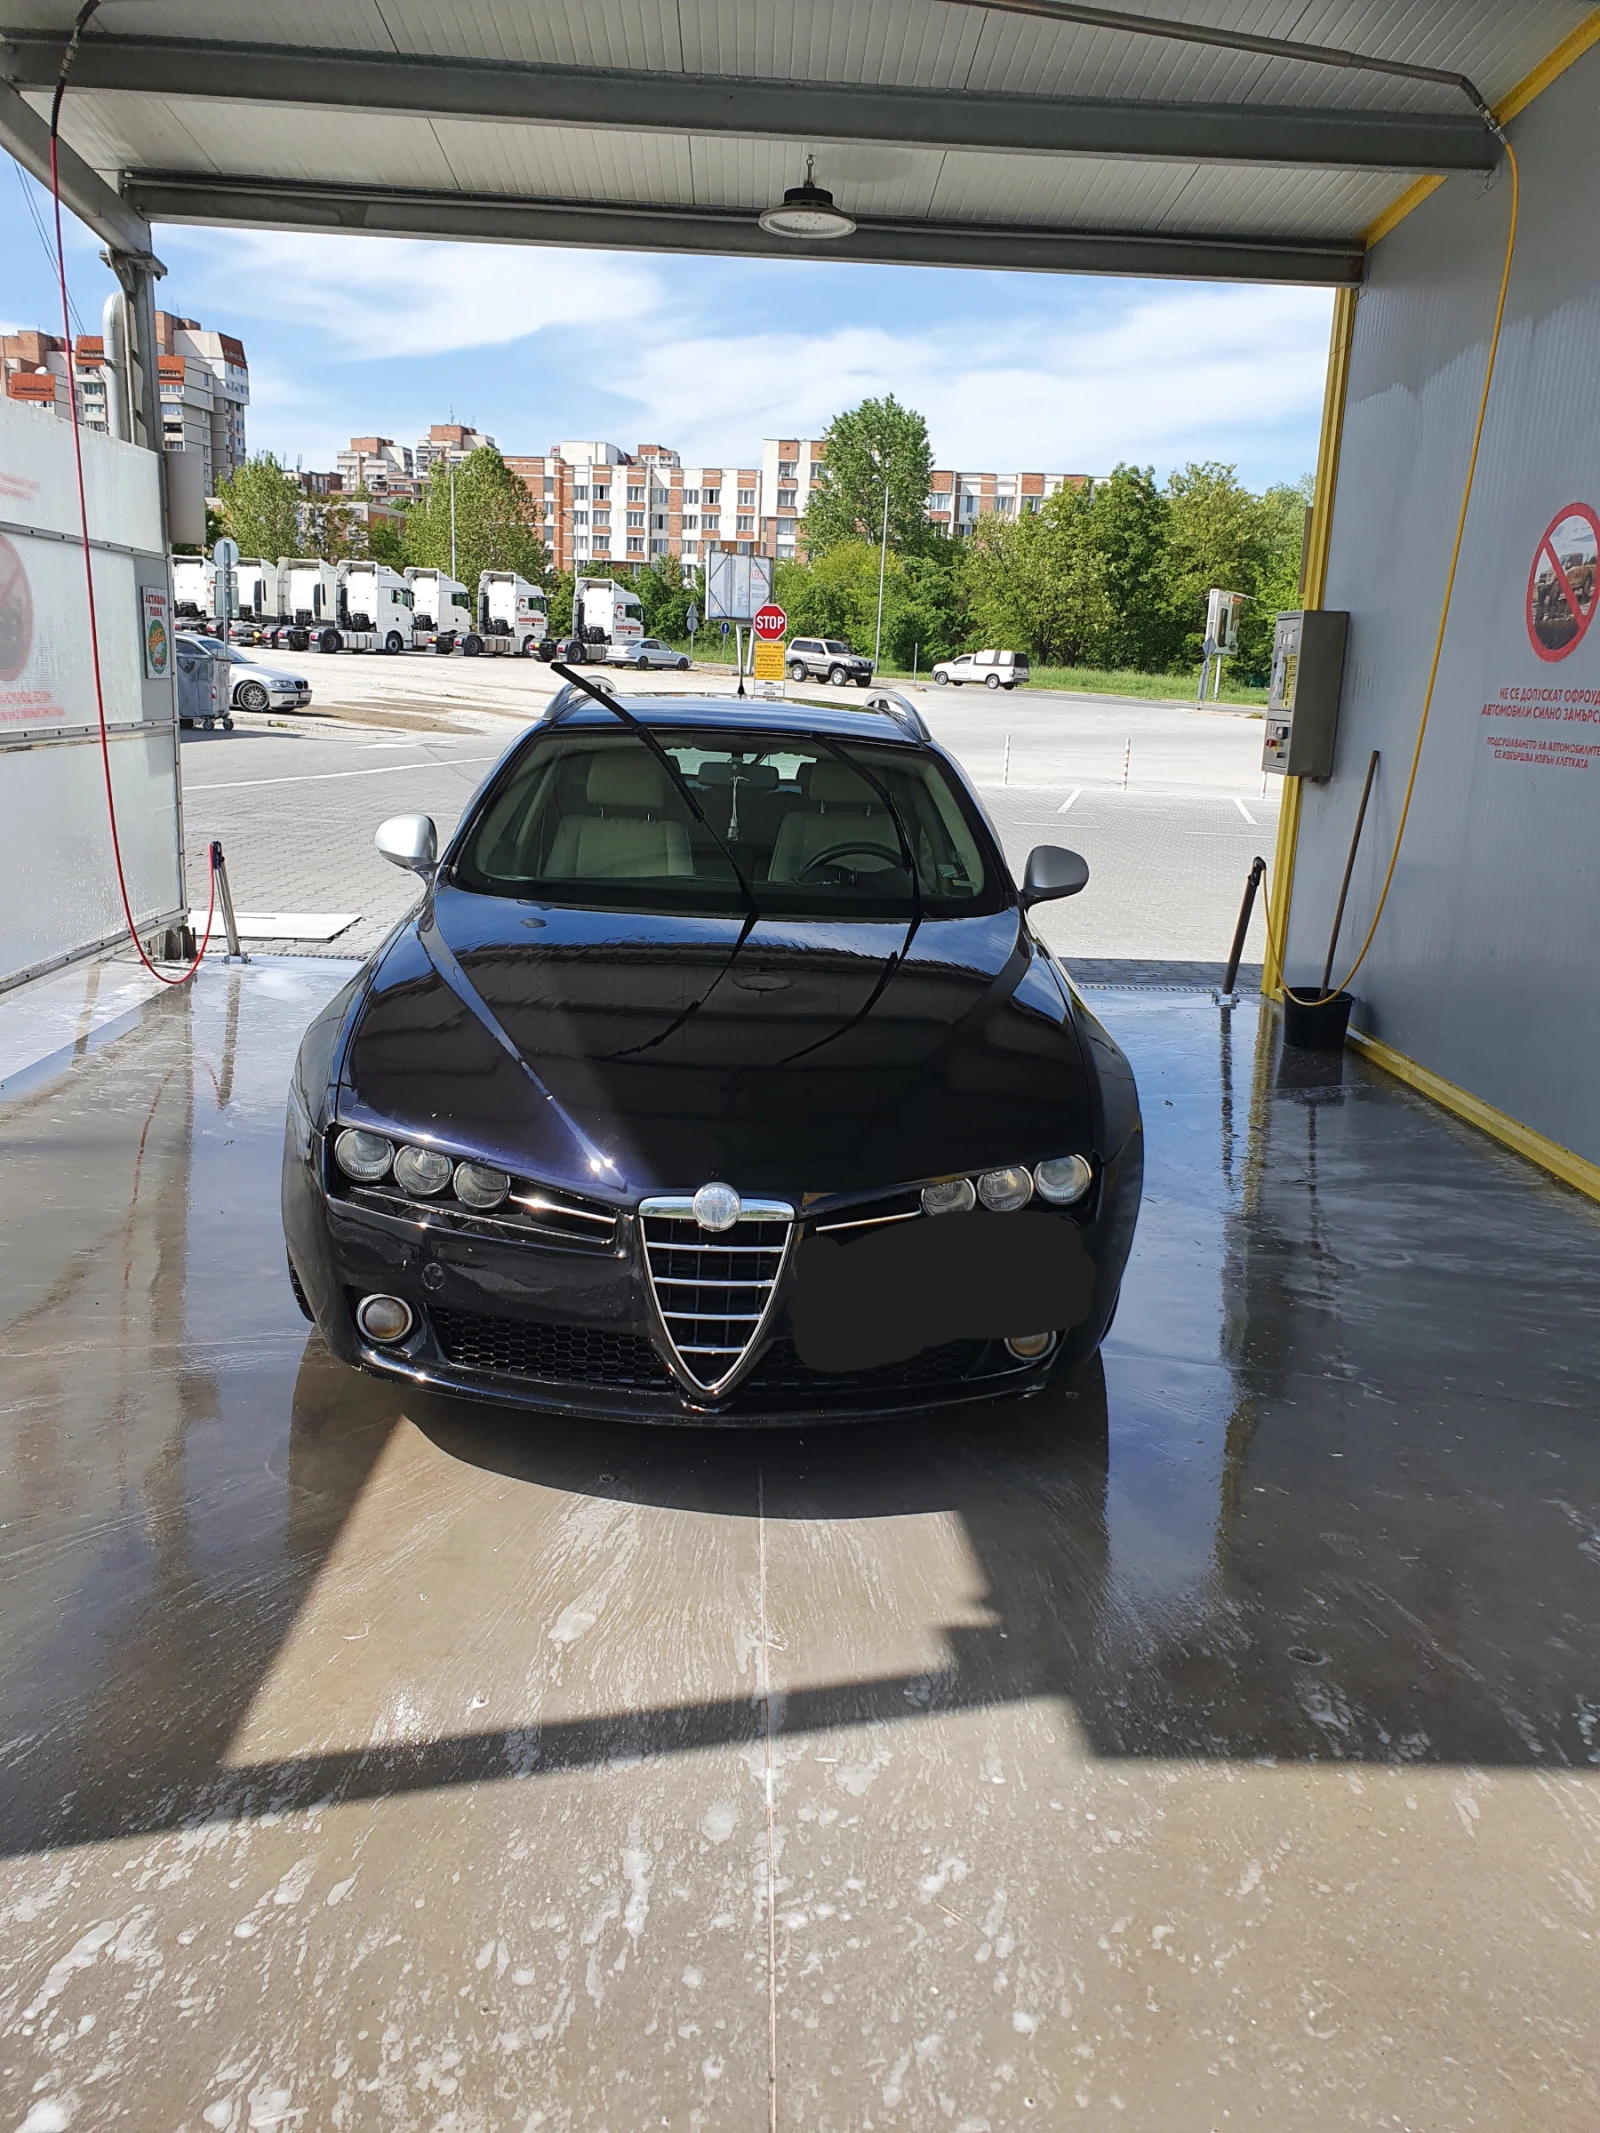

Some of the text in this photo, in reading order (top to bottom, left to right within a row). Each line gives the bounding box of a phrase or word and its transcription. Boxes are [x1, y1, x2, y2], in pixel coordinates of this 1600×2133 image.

[756, 615, 785, 630] STOP
[1499, 687, 1509, 699] НЕ
[1510, 687, 1520, 700] СЕ
[1520, 688, 1563, 702] ДОПУСКАТ
[1481, 704, 1532, 718] АВТОМОБИЛИ
[1533, 706, 1562, 720] СИЛНО
[1538, 740, 1547, 750] НА
[1548, 741, 1600, 757] АВТОМОБИЛИТЕ
[1494, 749, 1502, 759] СЕ
[1555, 756, 1588, 769] КЛЕТКАТА
